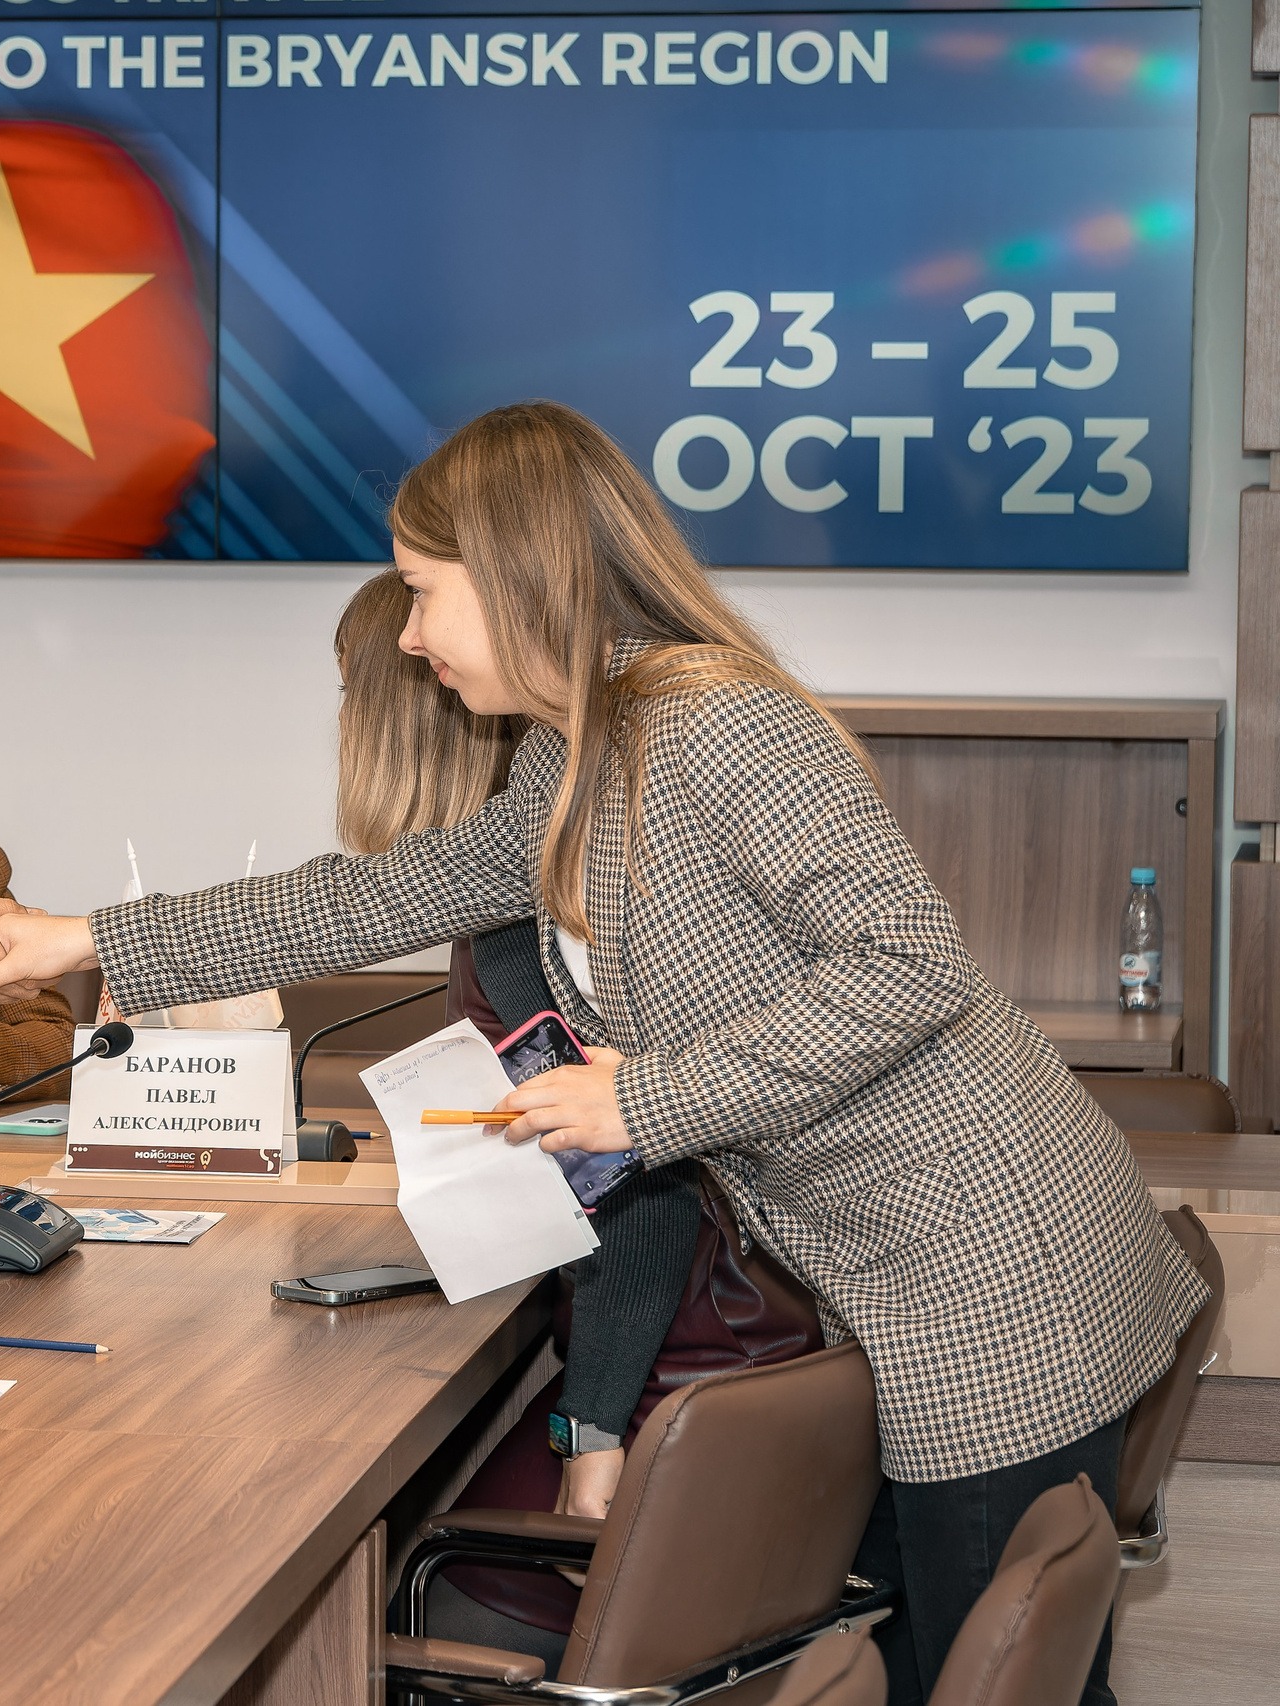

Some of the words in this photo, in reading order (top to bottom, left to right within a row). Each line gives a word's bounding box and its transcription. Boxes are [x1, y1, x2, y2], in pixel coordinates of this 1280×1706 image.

[62, 35, 205, 89] THE
[226, 32, 581, 88] BRYANSK
[601, 30, 889, 86] REGION
[688, 290, 839, 390] 23
[961, 290, 1120, 391] 25
[651, 415, 935, 514] OCT
[125, 1056, 237, 1075] БАРАНОВ
[145, 1088, 217, 1105] ПАВЕЛ
[92, 1116, 262, 1134] АЛЕКСАНДРОВИЧ
